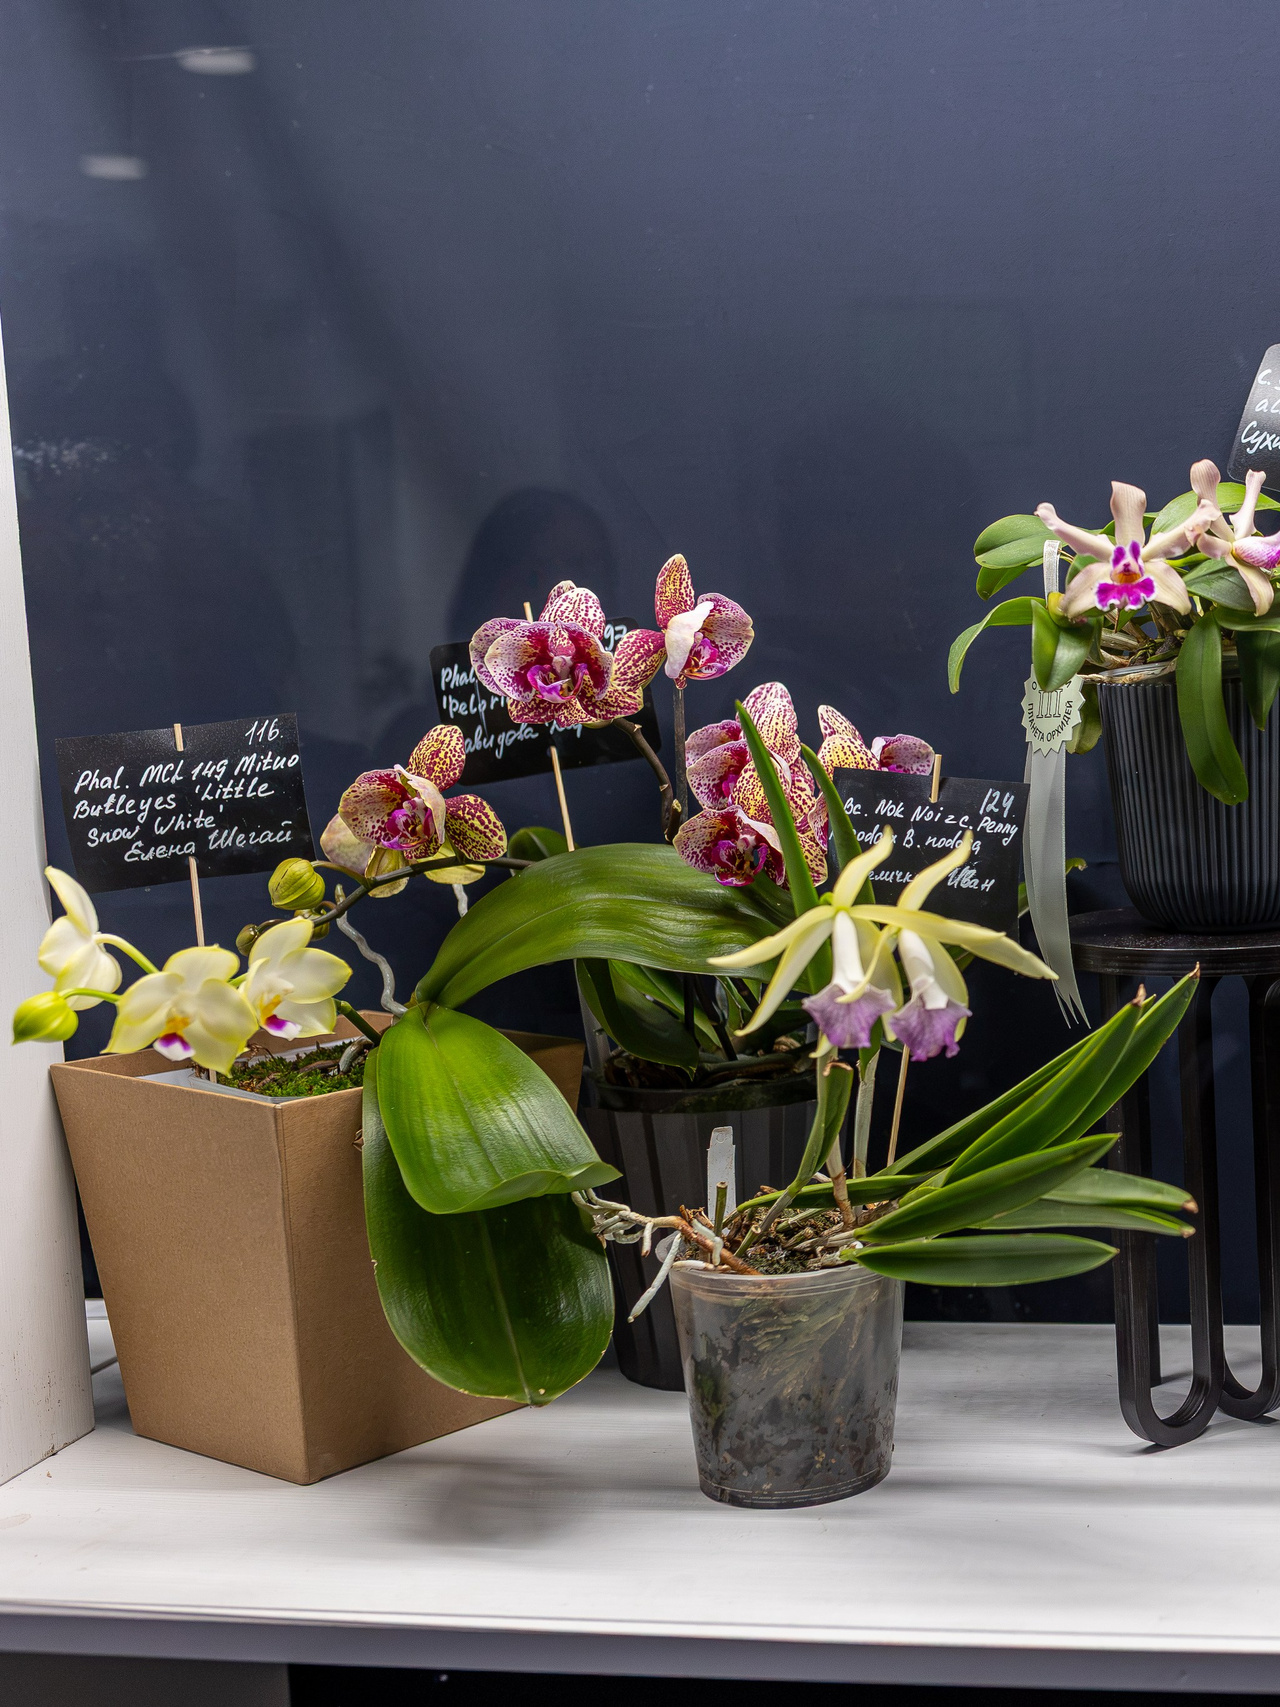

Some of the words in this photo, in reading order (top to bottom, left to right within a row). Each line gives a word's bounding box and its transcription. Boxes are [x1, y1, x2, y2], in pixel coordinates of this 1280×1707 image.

[1027, 703, 1045, 742] ПЛАНЕТА
[73, 766, 130, 795] Phal.
[86, 825, 141, 848] Snow
[875, 799, 904, 818] Nok
[976, 816, 1018, 846] Penny
[123, 840, 196, 864] Елена
[947, 865, 995, 892] Иван
